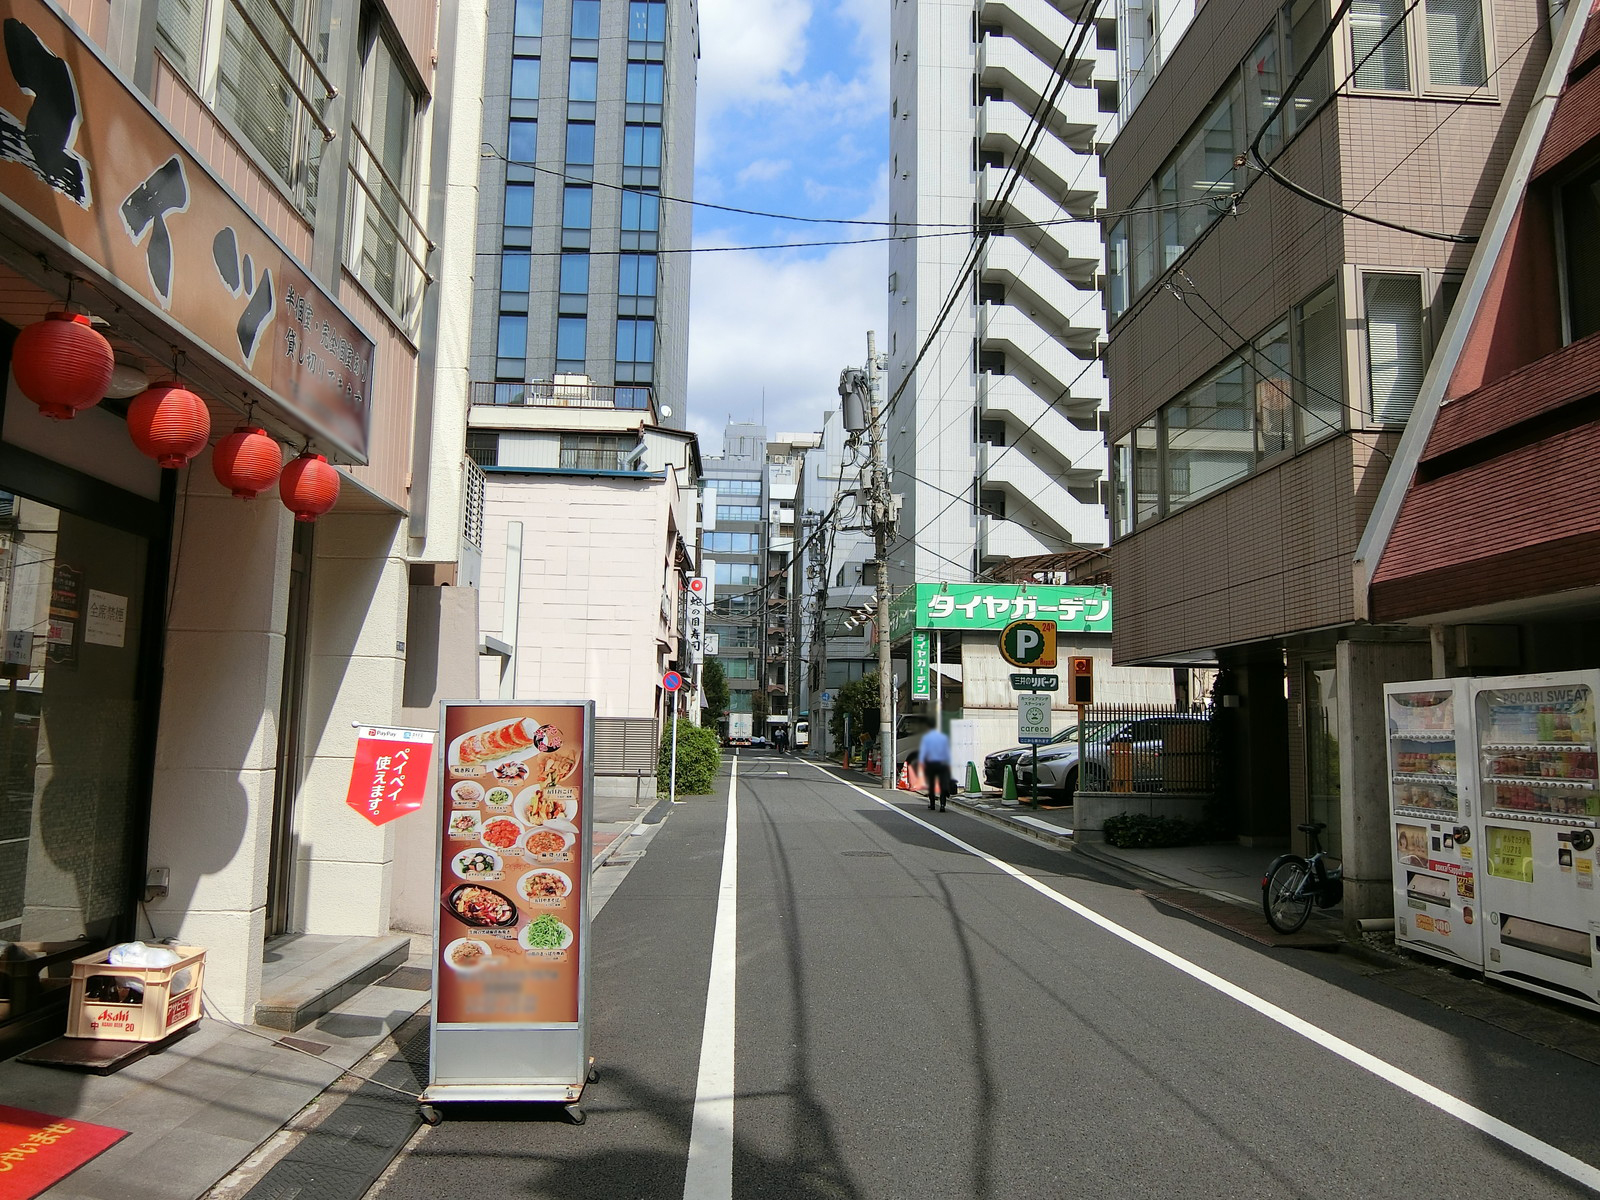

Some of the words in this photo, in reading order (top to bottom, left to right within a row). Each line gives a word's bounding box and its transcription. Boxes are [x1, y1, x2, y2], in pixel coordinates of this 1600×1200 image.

[285, 283, 369, 383] 半個室・完全個室あり
[89, 602, 126, 623] 全席禁煙
[928, 595, 1110, 621] タイヤガーデン
[1016, 629, 1039, 659] P
[917, 633, 927, 693] タイヤガーデン
[1014, 676, 1057, 688] 三井のリパーク
[1503, 691, 1544, 705] POCARI
[1547, 688, 1589, 703] SWEAT
[377, 730, 397, 738] PayPay
[388, 748, 411, 801] ペイペイ
[368, 756, 393, 816] 使えます。
[90, 1021, 99, 1030] 中
[97, 1009, 130, 1022] Asahi
[125, 1023, 135, 1032] 20
